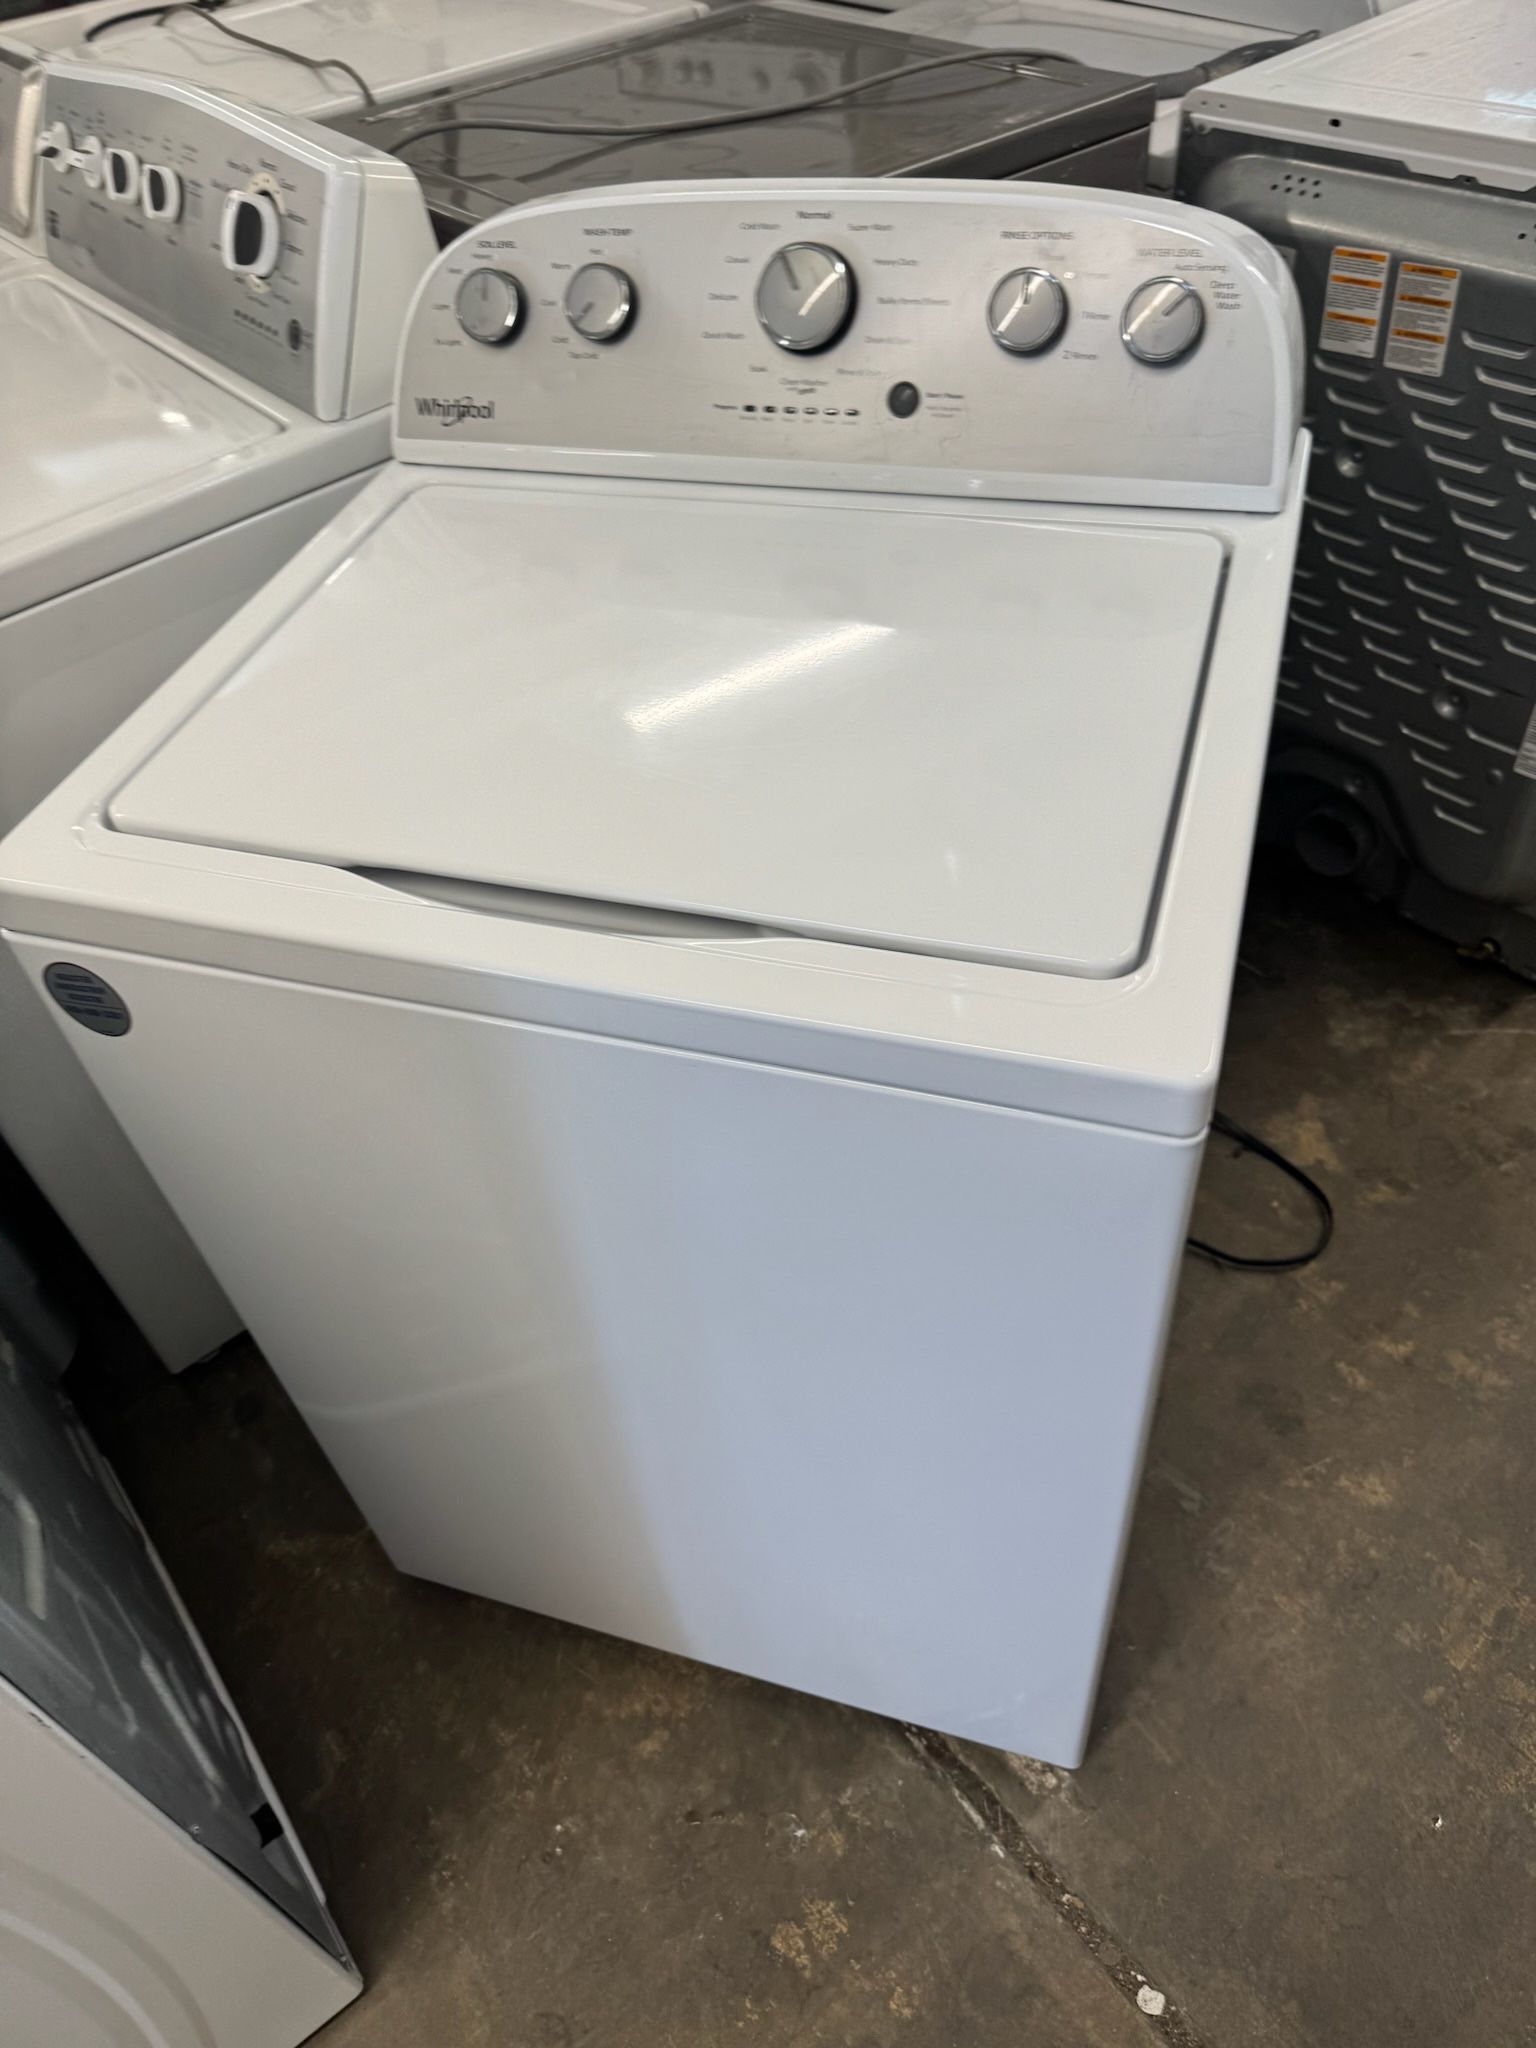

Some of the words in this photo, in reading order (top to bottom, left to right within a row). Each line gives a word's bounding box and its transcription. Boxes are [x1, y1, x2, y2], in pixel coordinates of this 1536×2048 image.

[797, 211, 832, 220] Normal
[583, 228, 608, 237] WASH
[609, 228, 633, 237] TEMP
[1000, 231, 1027, 240] RINSE
[1028, 231, 1075, 241] OPTIONS
[476, 240, 496, 249] SOIL
[497, 241, 518, 249] LEVEL
[1136, 248, 1168, 257] WATER
[1169, 248, 1203, 258] LEVEL
[1175, 264, 1197, 272] Auto
[1198, 264, 1229, 273] Sensing
[1210, 281, 1236, 290] Deep
[1213, 291, 1241, 300] Water
[1216, 302, 1242, 310] Wash
[415, 396, 496, 427] Whirlpool
